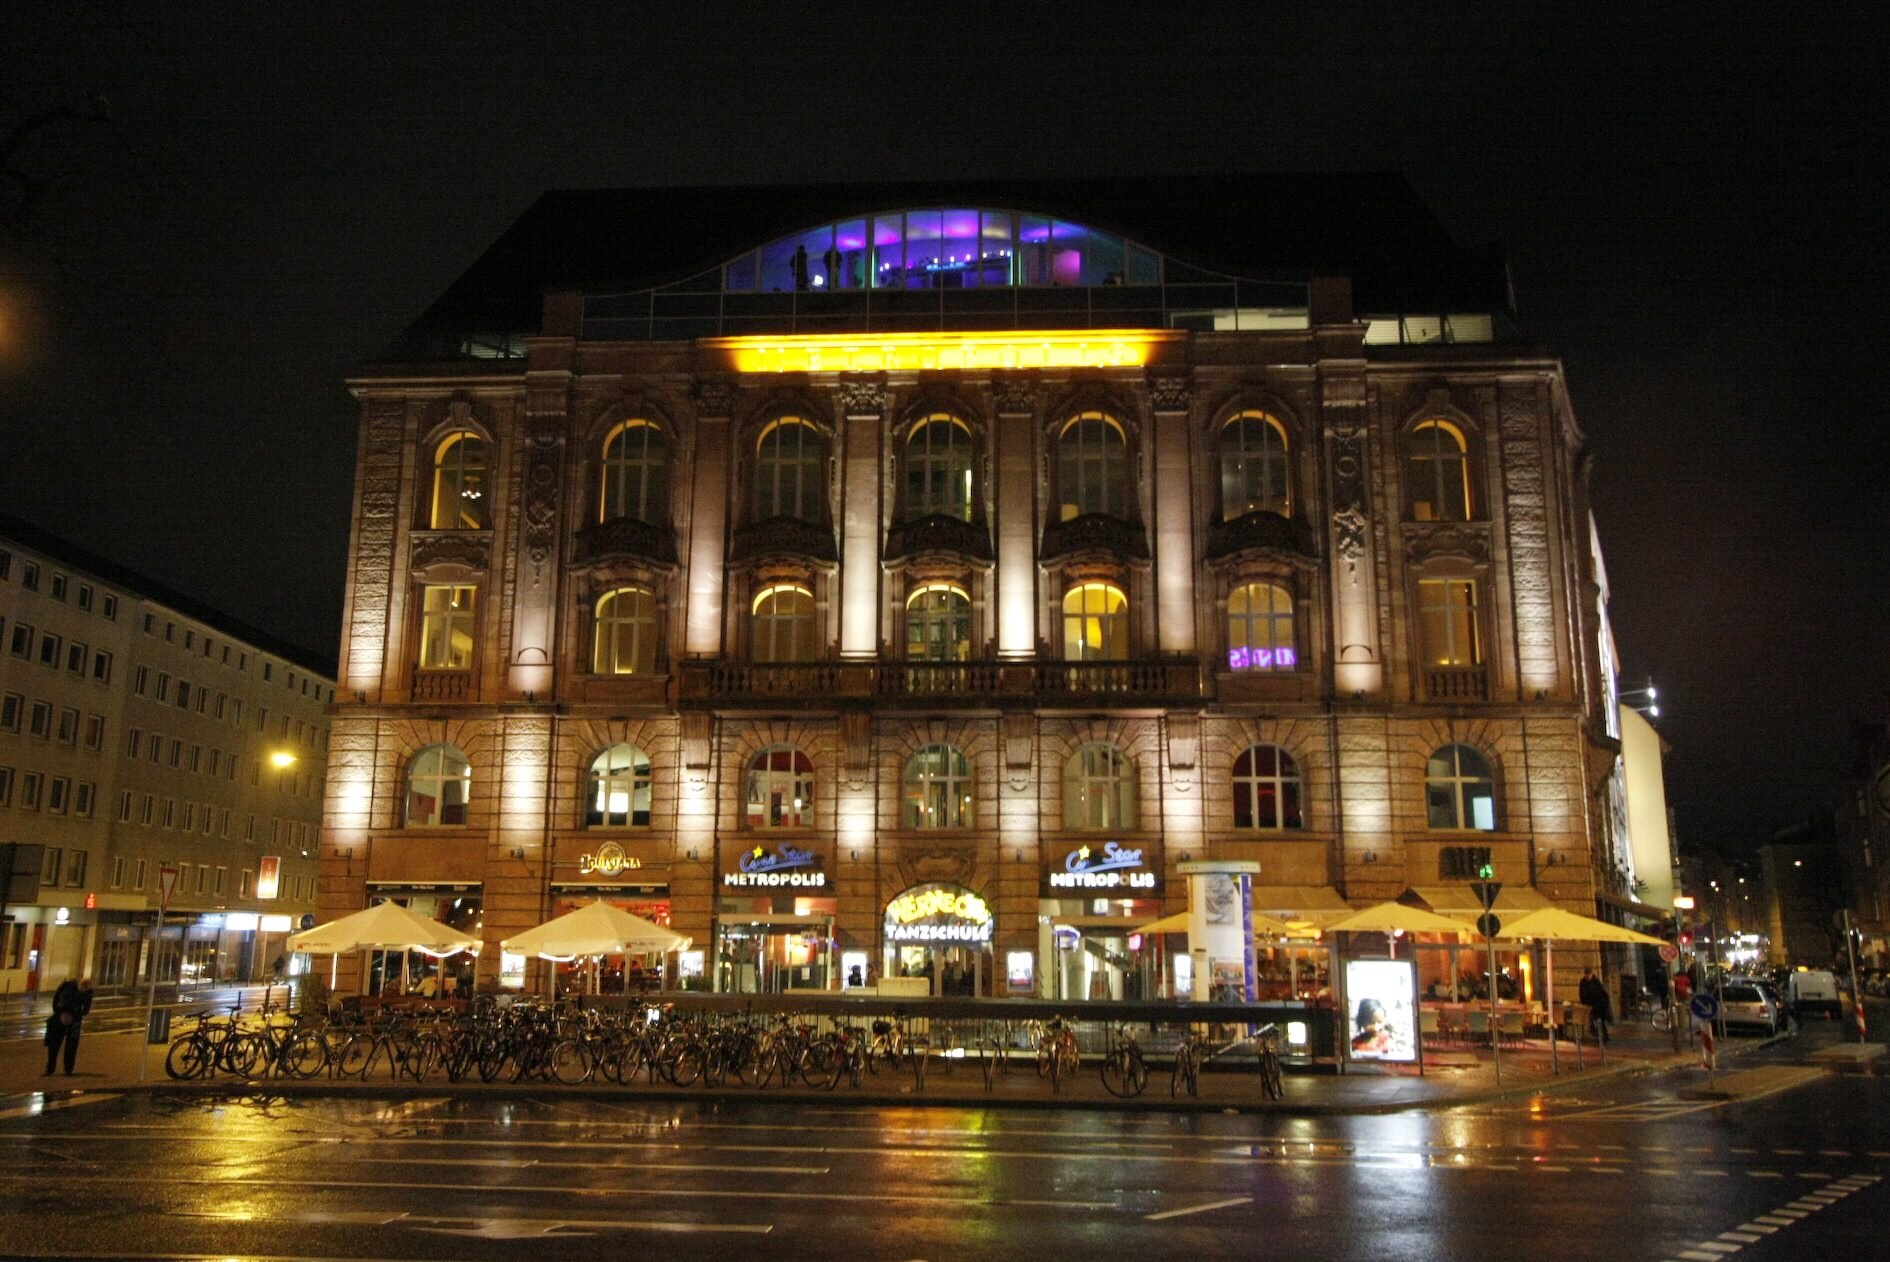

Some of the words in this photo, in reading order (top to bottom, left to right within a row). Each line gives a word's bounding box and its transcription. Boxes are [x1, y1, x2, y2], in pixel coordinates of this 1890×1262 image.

[1102, 842, 1143, 864] Star
[724, 873, 825, 886] METROPOLIS
[1050, 872, 1155, 887] METROPOLIS
[885, 925, 989, 940] TANZSCHULE
